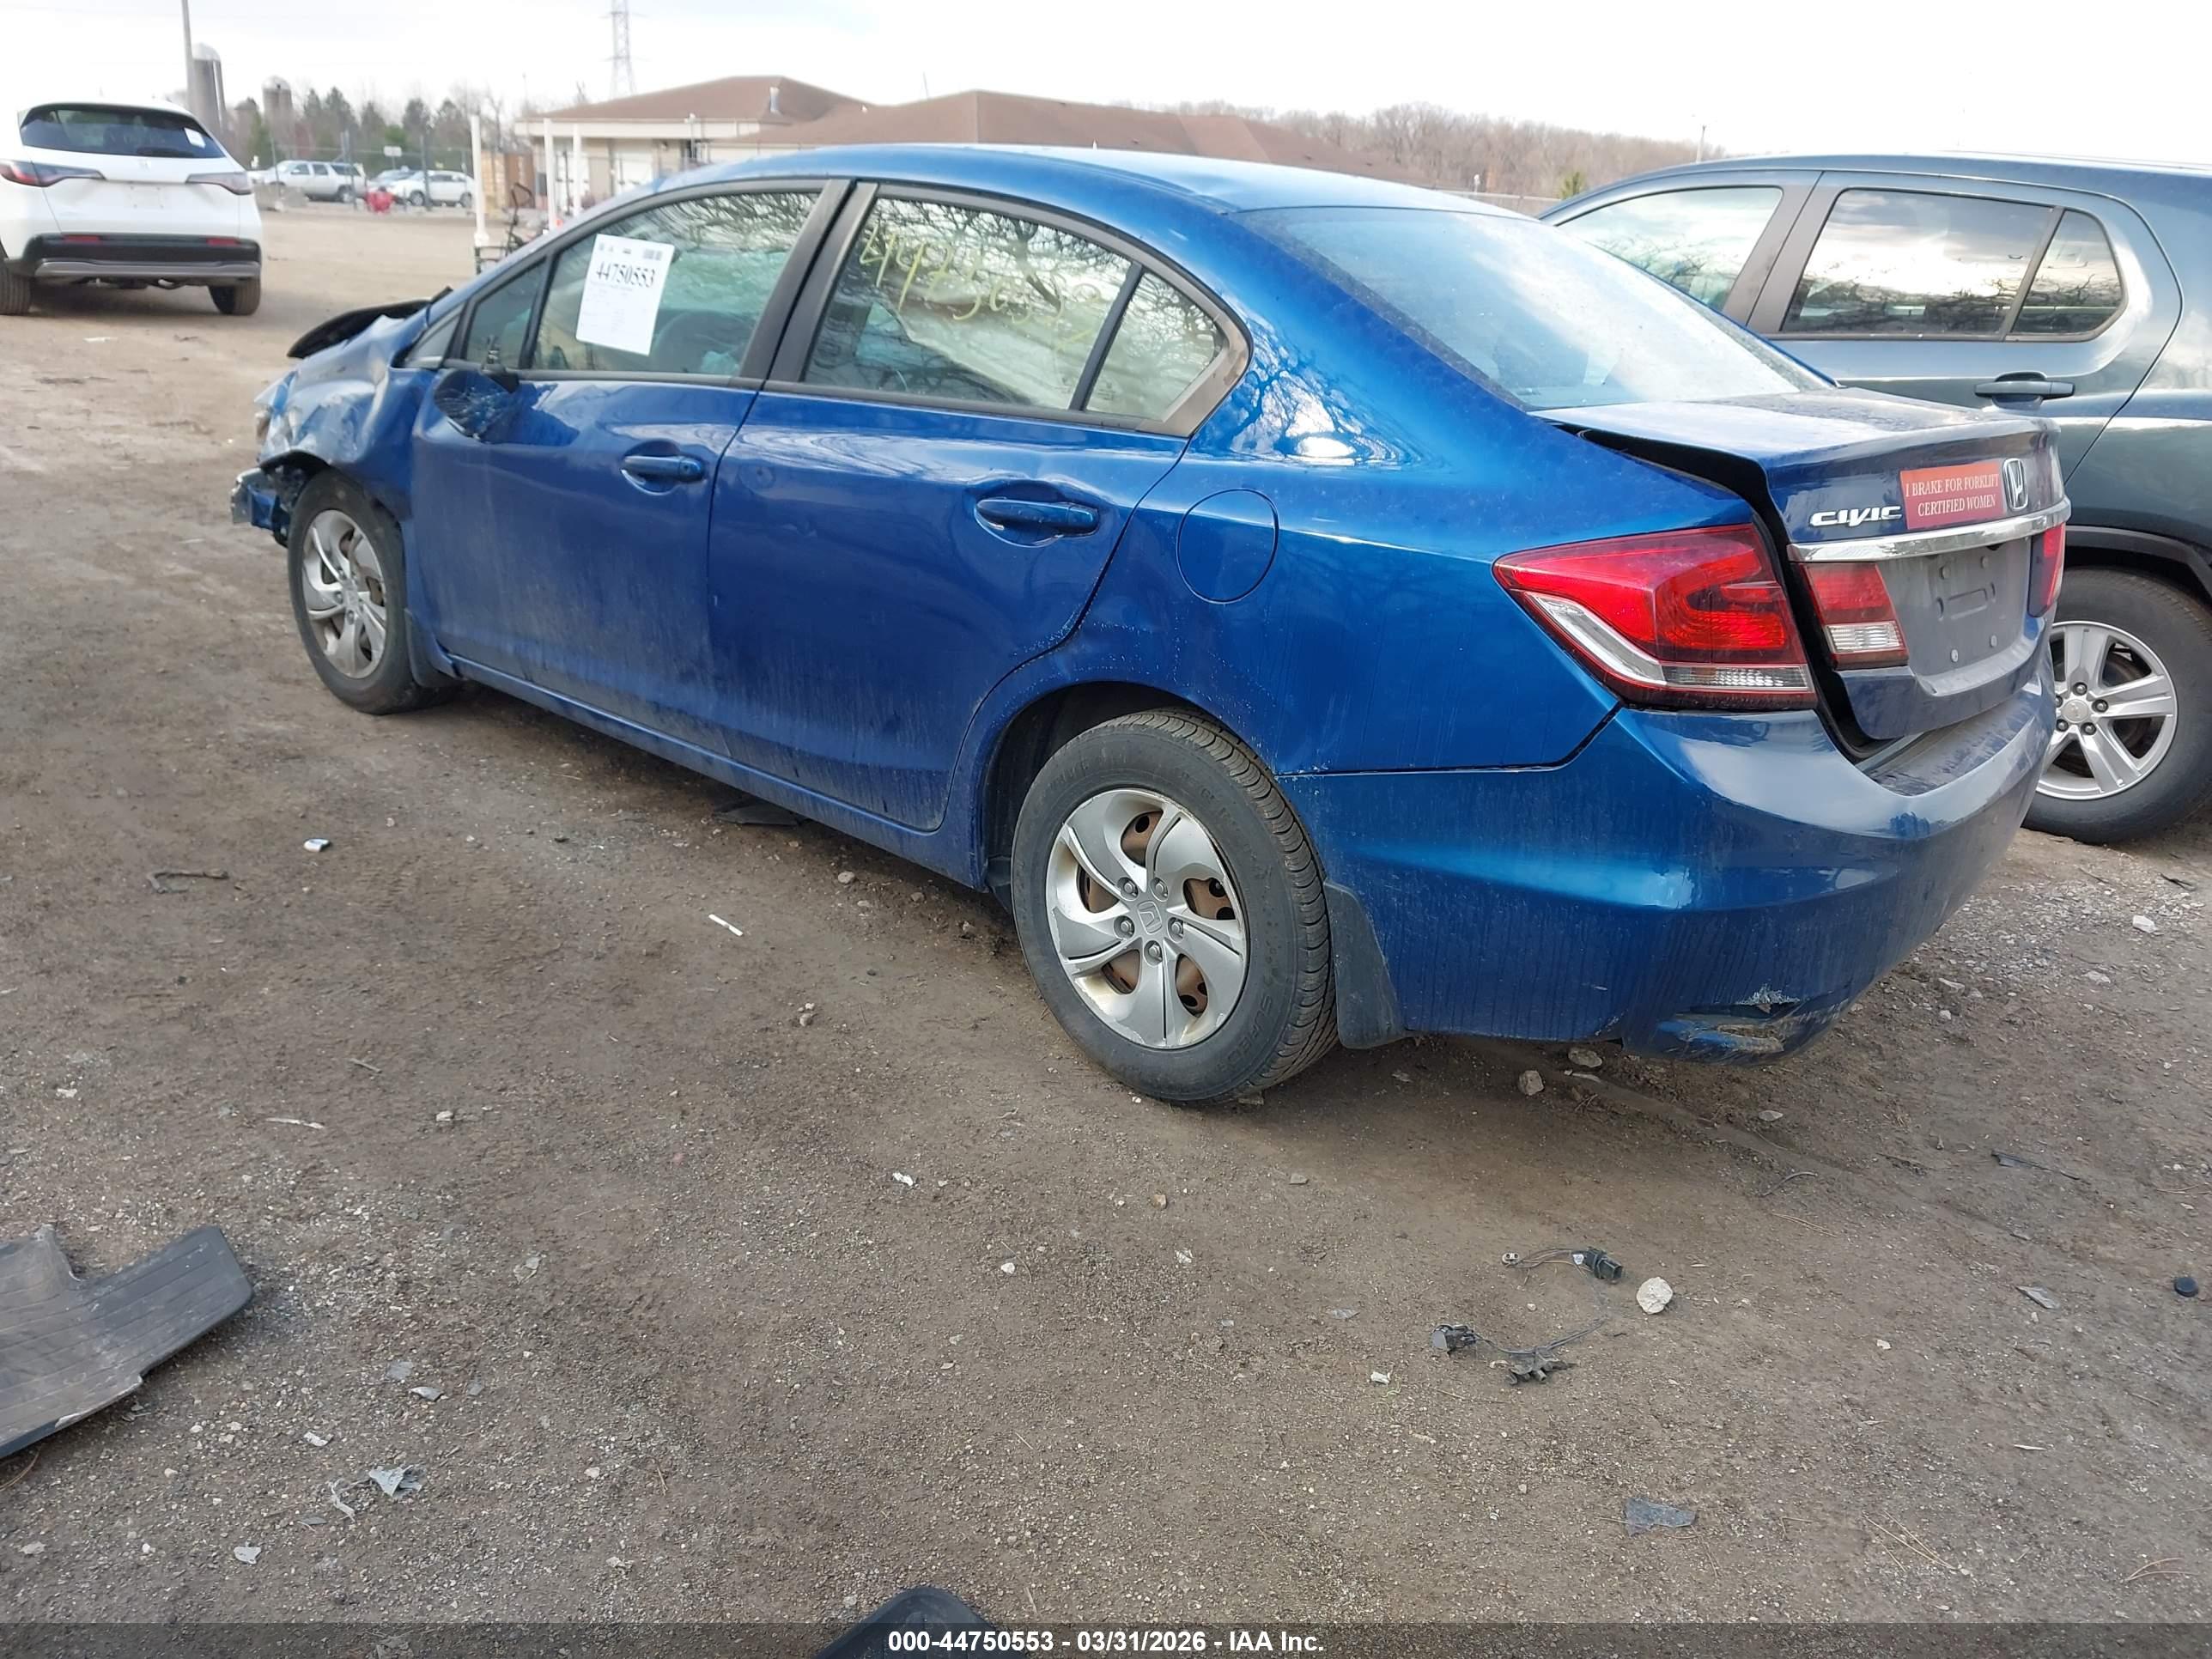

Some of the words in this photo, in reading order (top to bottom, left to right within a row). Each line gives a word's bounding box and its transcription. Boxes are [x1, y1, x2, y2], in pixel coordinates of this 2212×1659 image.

[596, 261, 655, 288] 44750553
[1905, 483, 1911, 496] I
[1912, 480, 1942, 496] BRAKE
[1945, 477, 1963, 492] FOR
[1964, 474, 1999, 490] FORKLIFT
[1810, 506, 1902, 526] CIVIC
[1917, 498, 1965, 516] CERTIFIED
[1967, 495, 1996, 511] WOMEN
